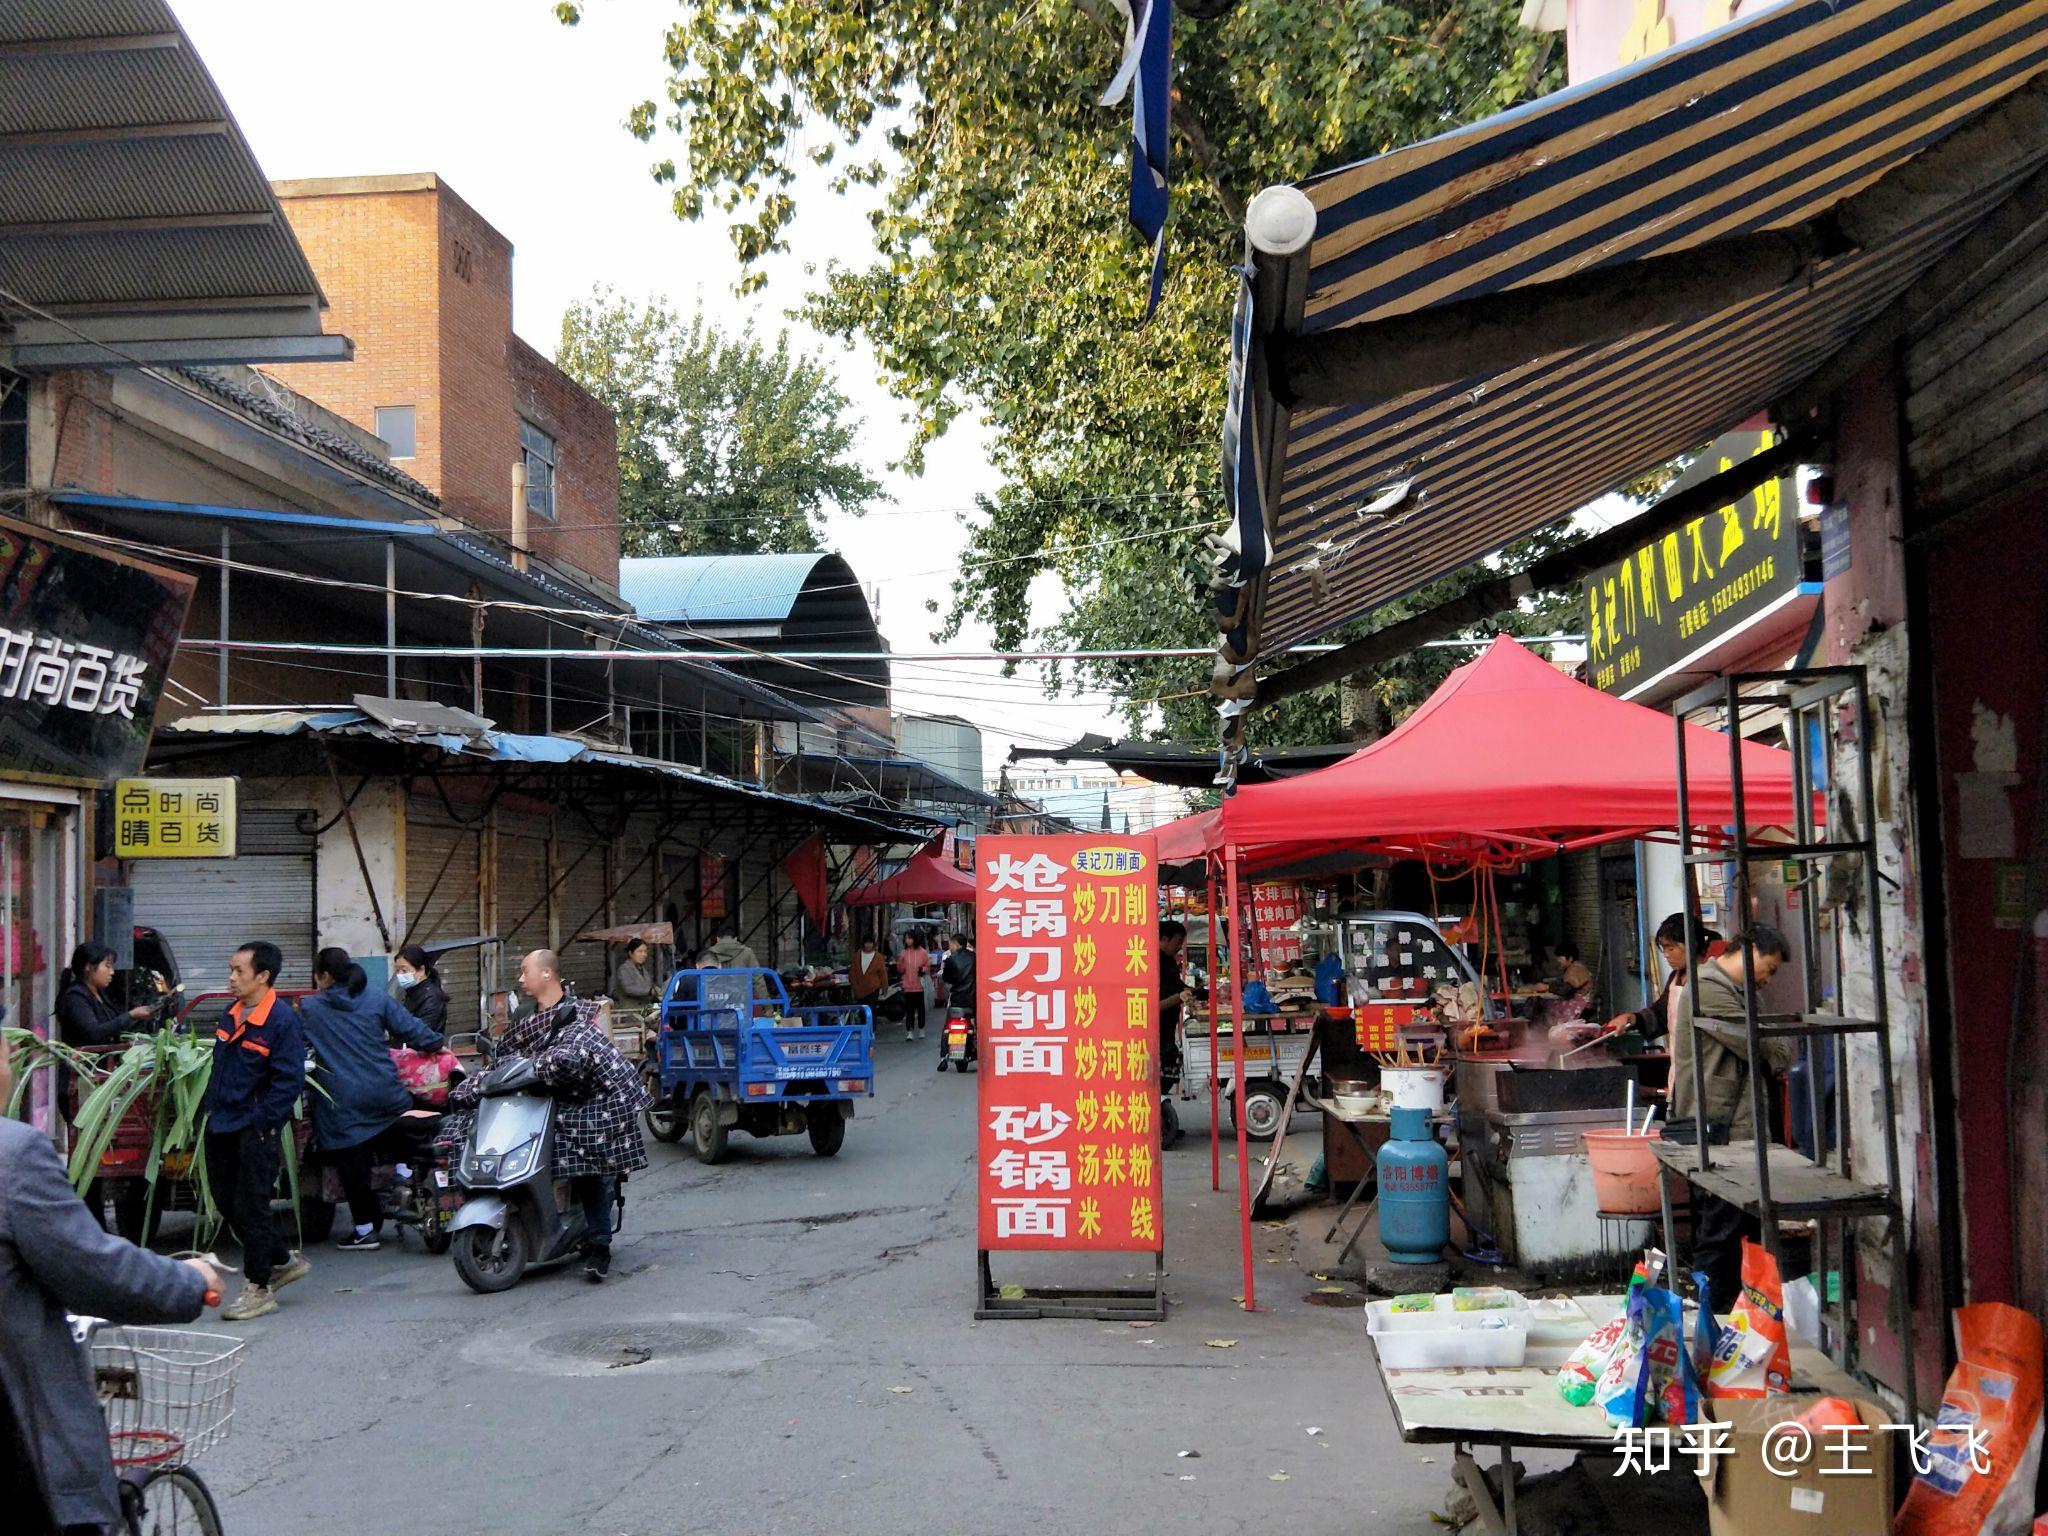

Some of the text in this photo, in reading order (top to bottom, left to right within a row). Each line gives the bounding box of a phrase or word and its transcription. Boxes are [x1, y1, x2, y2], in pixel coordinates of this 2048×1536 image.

[1077, 851, 1141, 871] 吴记刀削面
[1073, 883, 1147, 925] 炒刀削
[1252, 886, 1294, 901] 大排面
[986, 853, 1068, 1076] 炝锅刀削面
[1075, 1038, 1149, 1081] 炒河粉
[1075, 1091, 1152, 1134] 炒米粉
[988, 1103, 1072, 1238] 砂锅面
[1077, 1143, 1152, 1187] 汤米粉
